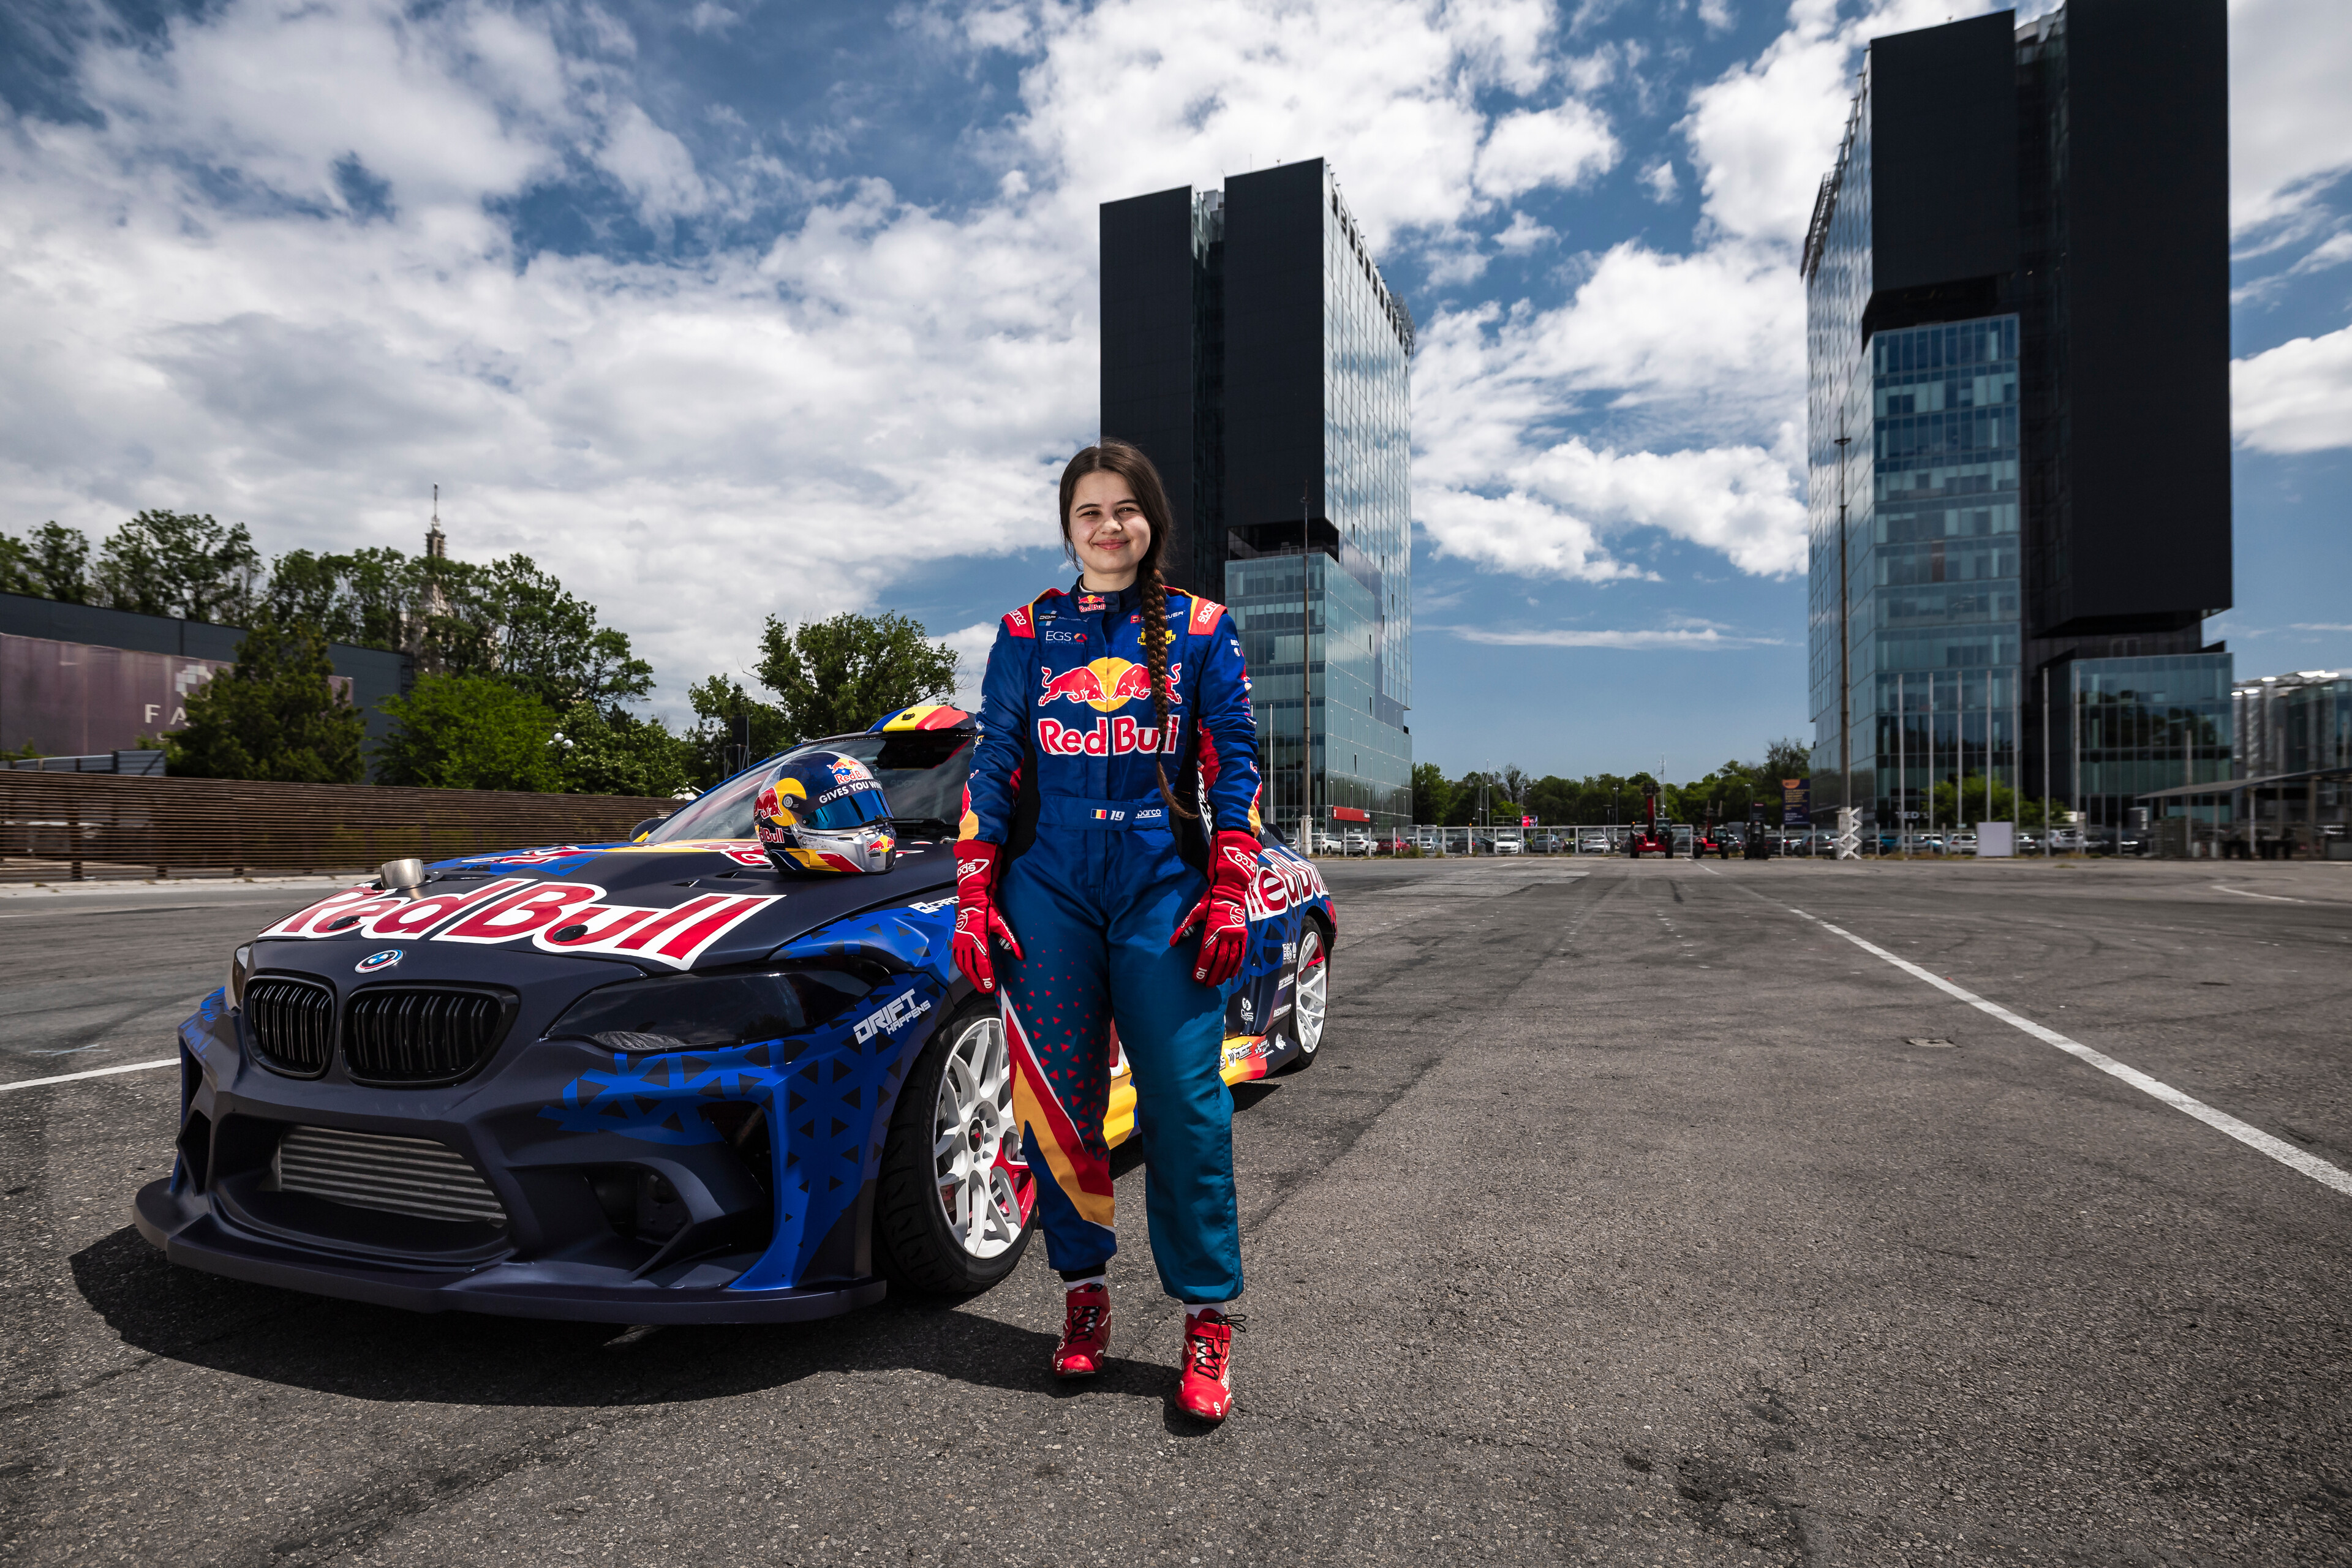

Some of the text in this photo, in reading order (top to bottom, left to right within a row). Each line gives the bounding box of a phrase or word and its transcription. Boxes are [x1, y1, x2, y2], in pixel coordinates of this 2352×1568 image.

[1079, 603, 1091, 612] Red
[1197, 601, 1218, 624] spar
[1011, 609, 1027, 625] arco
[1046, 630, 1072, 641] EGS
[1038, 717, 1109, 757] Red
[834, 769, 869, 785] Red Bull
[819, 780, 883, 804] GIVES YOU WIN
[1110, 810, 1125, 821] 19
[1136, 809, 1162, 819] parco
[763, 827, 785, 843] Bull
[258, 878, 786, 971] Red Bull
[853, 988, 916, 1044] DRIFT
[886, 1000, 931, 1035] HAPPENS
